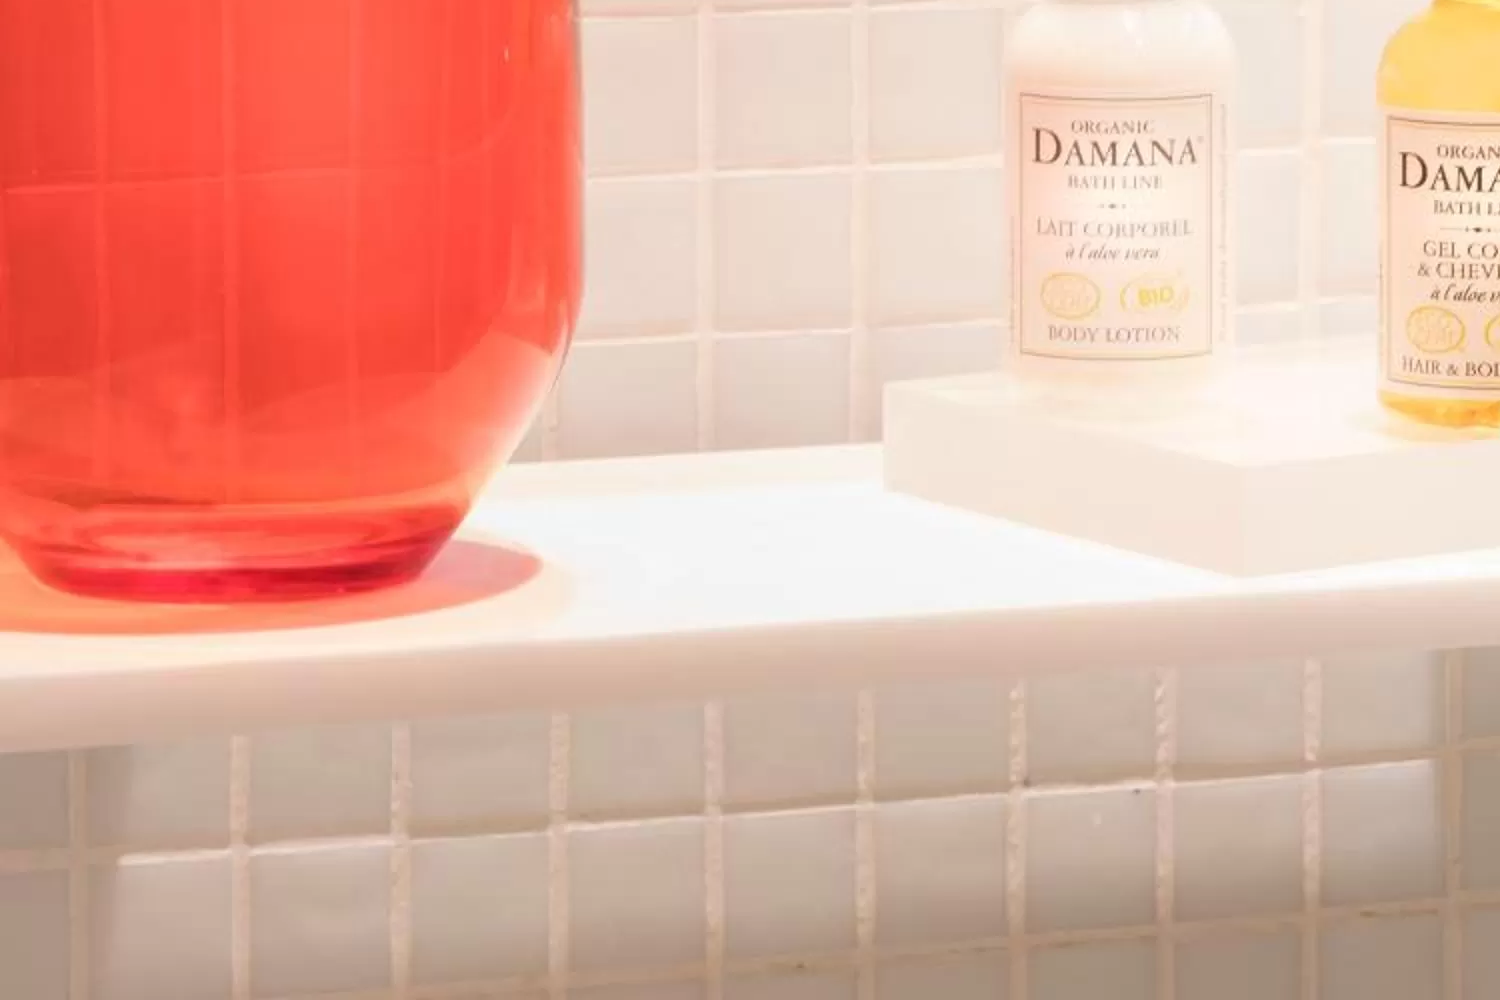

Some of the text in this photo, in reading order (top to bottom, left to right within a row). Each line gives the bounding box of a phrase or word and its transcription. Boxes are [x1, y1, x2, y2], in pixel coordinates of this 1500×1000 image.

[1070, 119, 1156, 135] ORGANIC
[1067, 175, 1164, 190] BATH LINE
[1433, 199, 1481, 215] BATH
[1036, 216, 1195, 238] LAIT CORPOREL
[1124, 247, 1161, 261] vera
[1423, 240, 1461, 258] GEL
[1417, 264, 1431, 278] &
[1430, 284, 1441, 301] à
[1048, 325, 1182, 344] BODY LOTION
[1401, 356, 1442, 375] HAIR
[1446, 363, 1460, 377] &
